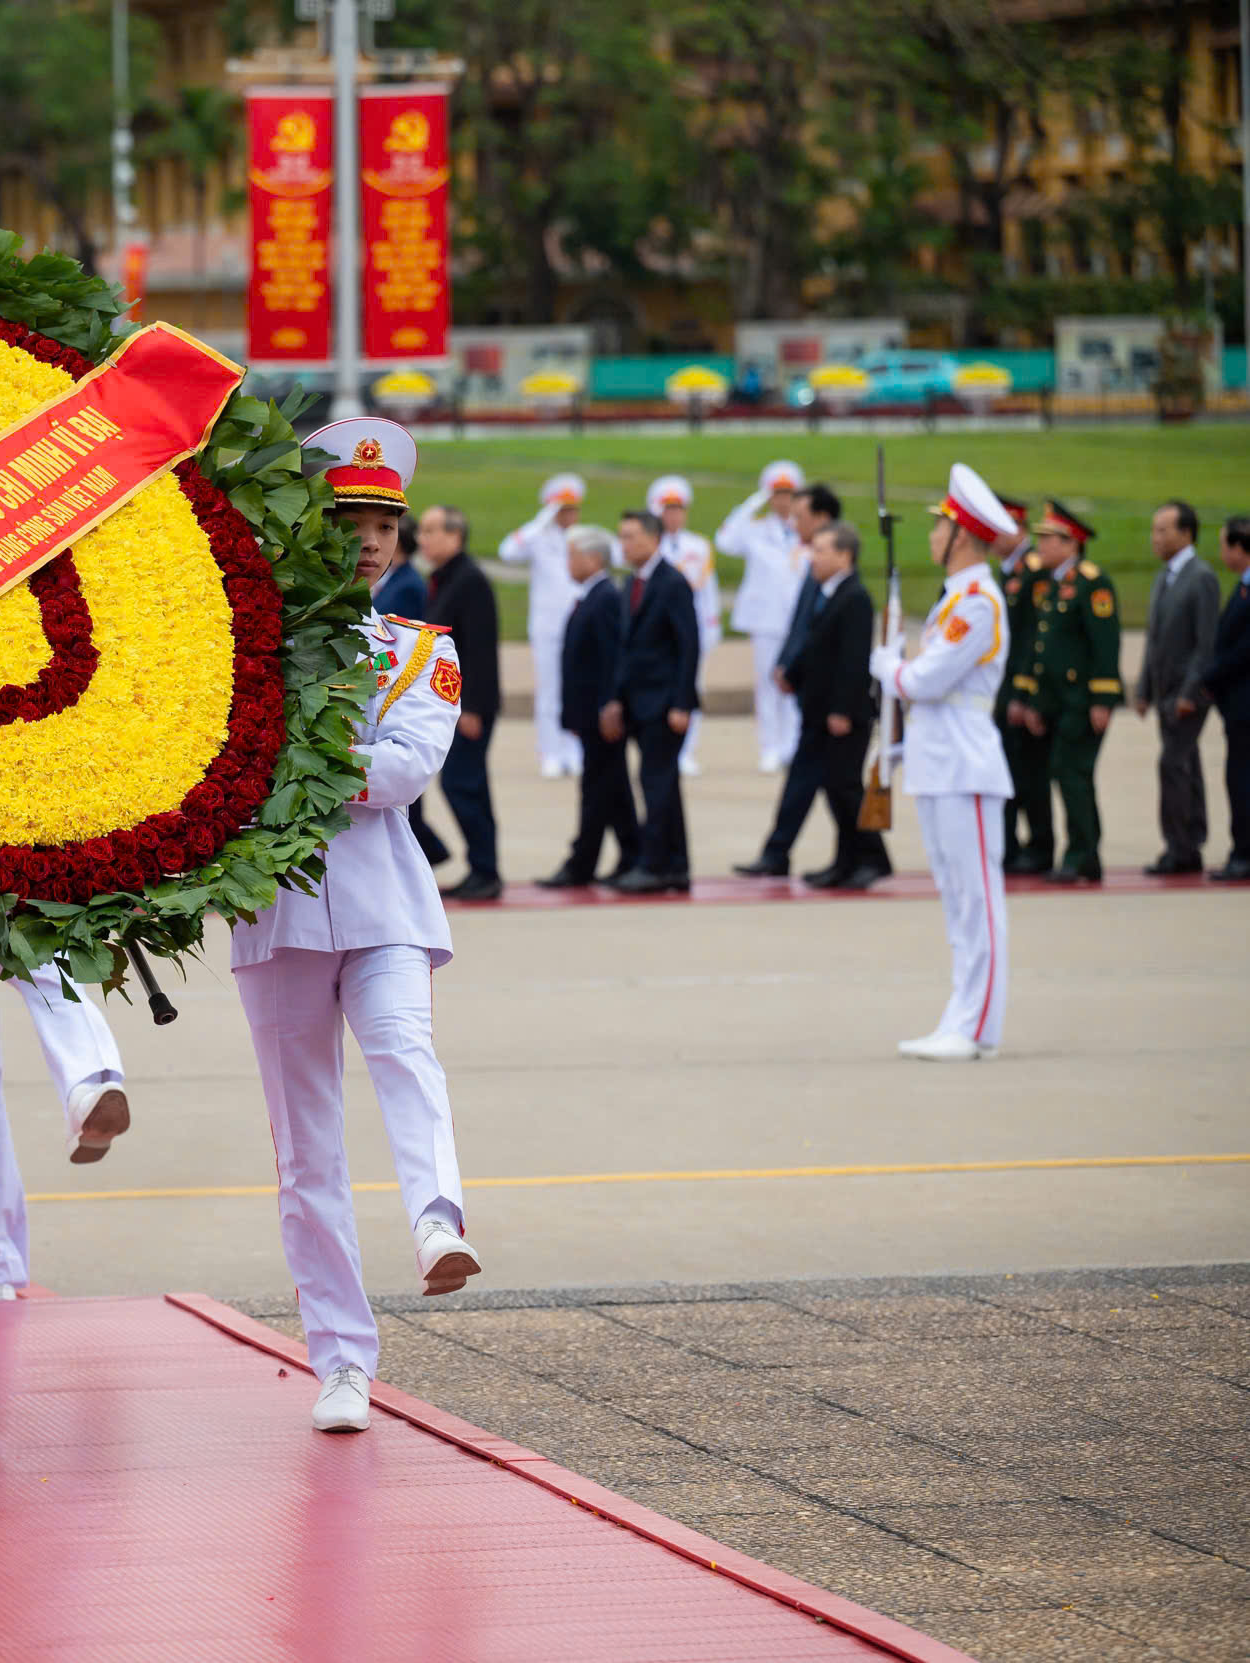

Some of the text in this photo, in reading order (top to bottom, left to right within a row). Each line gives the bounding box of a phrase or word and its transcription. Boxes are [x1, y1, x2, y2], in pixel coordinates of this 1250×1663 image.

[49, 420, 95, 456] VĨ
[67, 405, 124, 442] ĐẠI
[7, 437, 78, 491] MINH
[15, 515, 57, 545] CỘNG
[37, 498, 78, 527] SẢN
[58, 484, 98, 511] VIỆT
[79, 464, 119, 497] NAM
